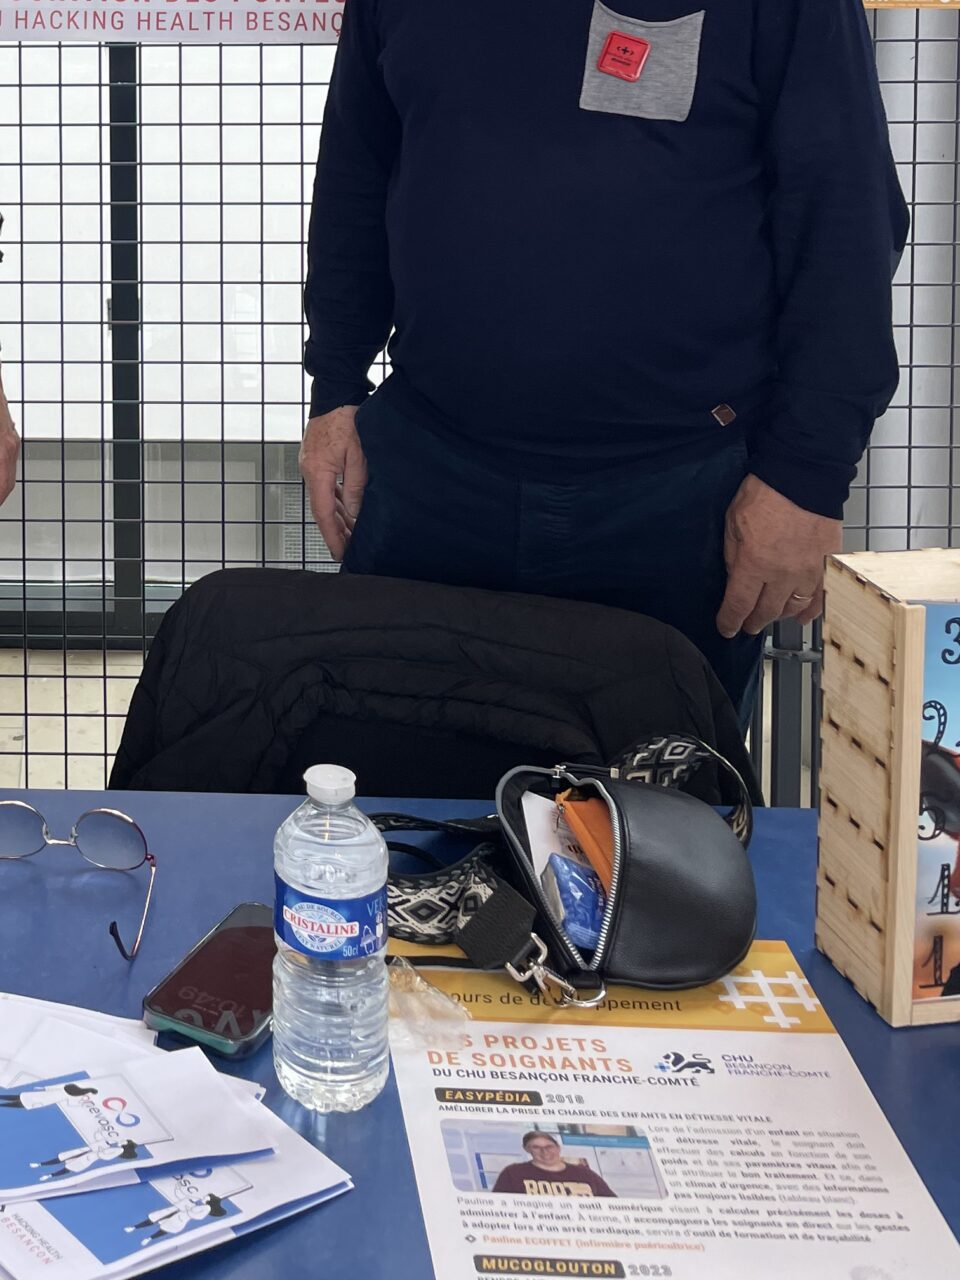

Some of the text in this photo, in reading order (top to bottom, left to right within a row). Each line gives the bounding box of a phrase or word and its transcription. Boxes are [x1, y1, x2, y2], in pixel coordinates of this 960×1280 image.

[14, 11, 125, 30] HACKING
[137, 11, 234, 31] HEALTH
[284, 909, 358, 935] CRISTALINE
[342, 945, 359, 957] 50cl
[500, 992, 523, 1006] de
[484, 1034, 608, 1053] PROJETS
[427, 1050, 634, 1072] DE SOIGNANTS
[721, 1054, 754, 1063] CHU
[432, 1068, 700, 1087] DU CHU BESANÇON FRANCHE-COMTÉ
[445, 1088, 585, 1104] EASYPÉDIA 2018
[438, 1104, 494, 1115] AMÉLIORER
[496, 1107, 509, 1116] LA
[511, 1107, 540, 1117] PRISE
[542, 1109, 555, 1117] EN
[558, 1109, 598, 1118] CHARGE
[600, 1111, 620, 1119] DES
[621, 1111, 667, 1120] ENFANTS
[685, 1113, 735, 1122] DÉTRESSE
[676, 1137, 719, 1145] détresse
[768, 1129, 800, 1137] enfant
[745, 1160, 802, 1169] paramètres
[684, 1180, 890, 1193] climat informations
[694, 1192, 777, 1202] toujours lisibles
[456, 1196, 831, 1218] Pauline imaginé numérique calculer précisément
[460, 1209, 783, 1229] administrer accompagnera soignants
[471, 1221, 786, 1240] adopter formation
[482, 1235, 523, 1244] Pauline
[0, 1216, 53, 1265] BESANÇON
[482, 1257, 616, 1275] MUCOGLOUTON
